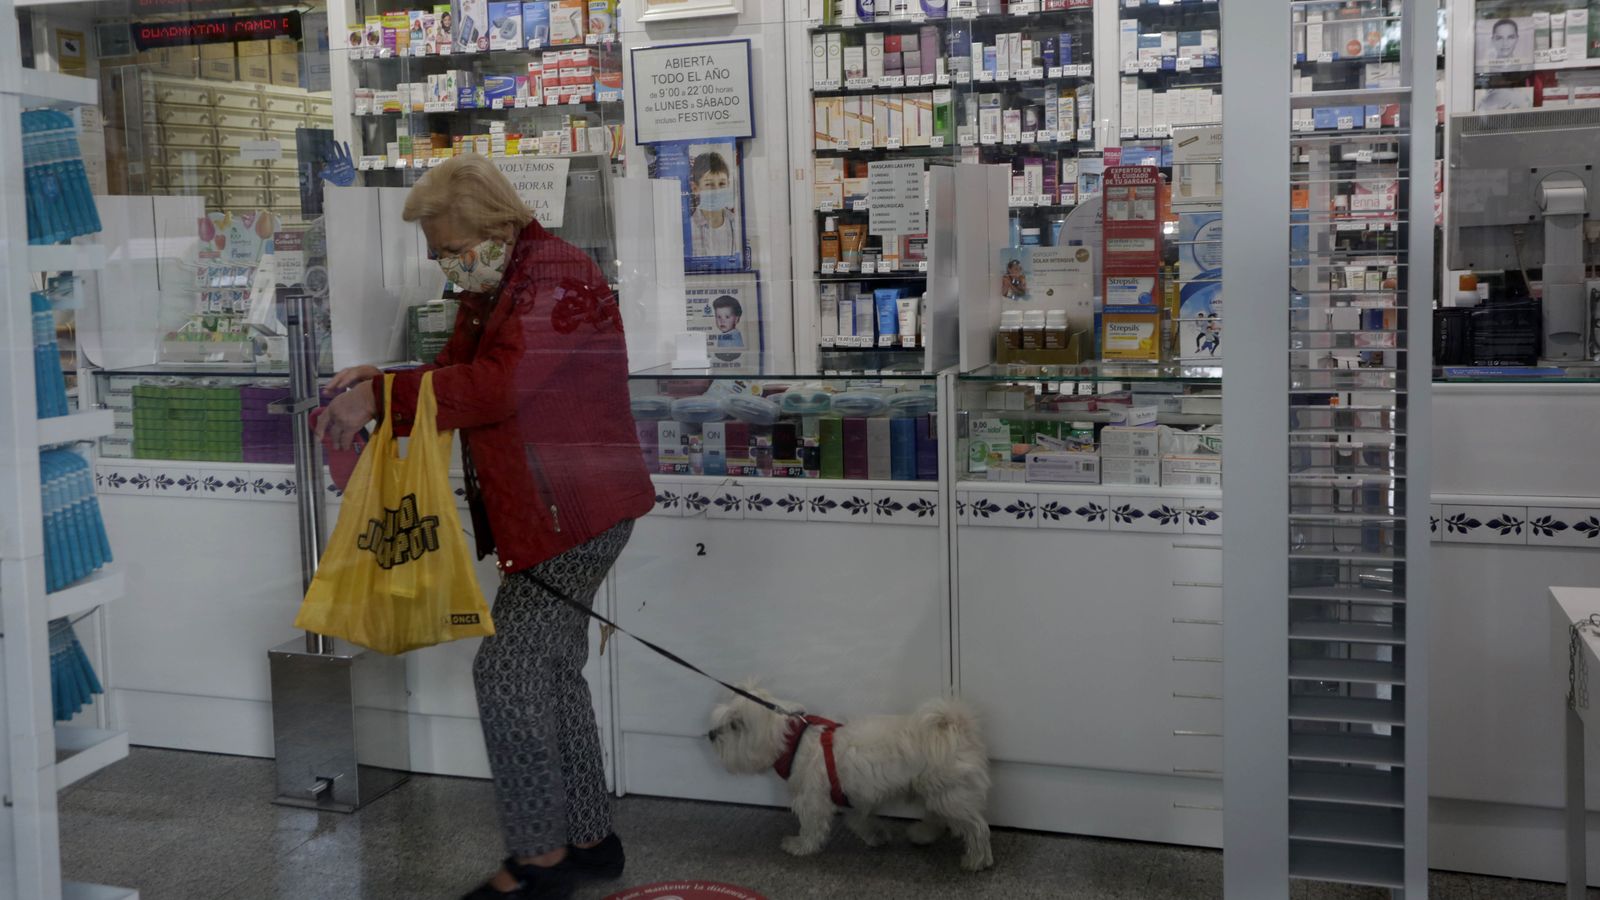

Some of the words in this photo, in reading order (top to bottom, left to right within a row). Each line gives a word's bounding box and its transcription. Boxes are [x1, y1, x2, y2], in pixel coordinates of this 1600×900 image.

[665, 56, 715, 69] ABIERTA
[651, 72, 684, 85] TODO
[688, 71, 702, 82] EL
[705, 68, 730, 80] AÑO
[715, 86, 734, 94] horas
[654, 100, 689, 111] LUNES
[696, 95, 740, 108] SÁBADO
[678, 110, 730, 122] FESTIVOS
[498, 163, 554, 172] VOLVEMOS
[1354, 199, 1380, 207] enna
[1109, 278, 1140, 286] Strepsils
[1109, 324, 1140, 332] Strepsils
[662, 430, 676, 438] ON
[706, 430, 720, 440] ON
[696, 543, 707, 556] 2
[453, 615, 478, 624] ONCE
[644, 884, 690, 894] mantener
